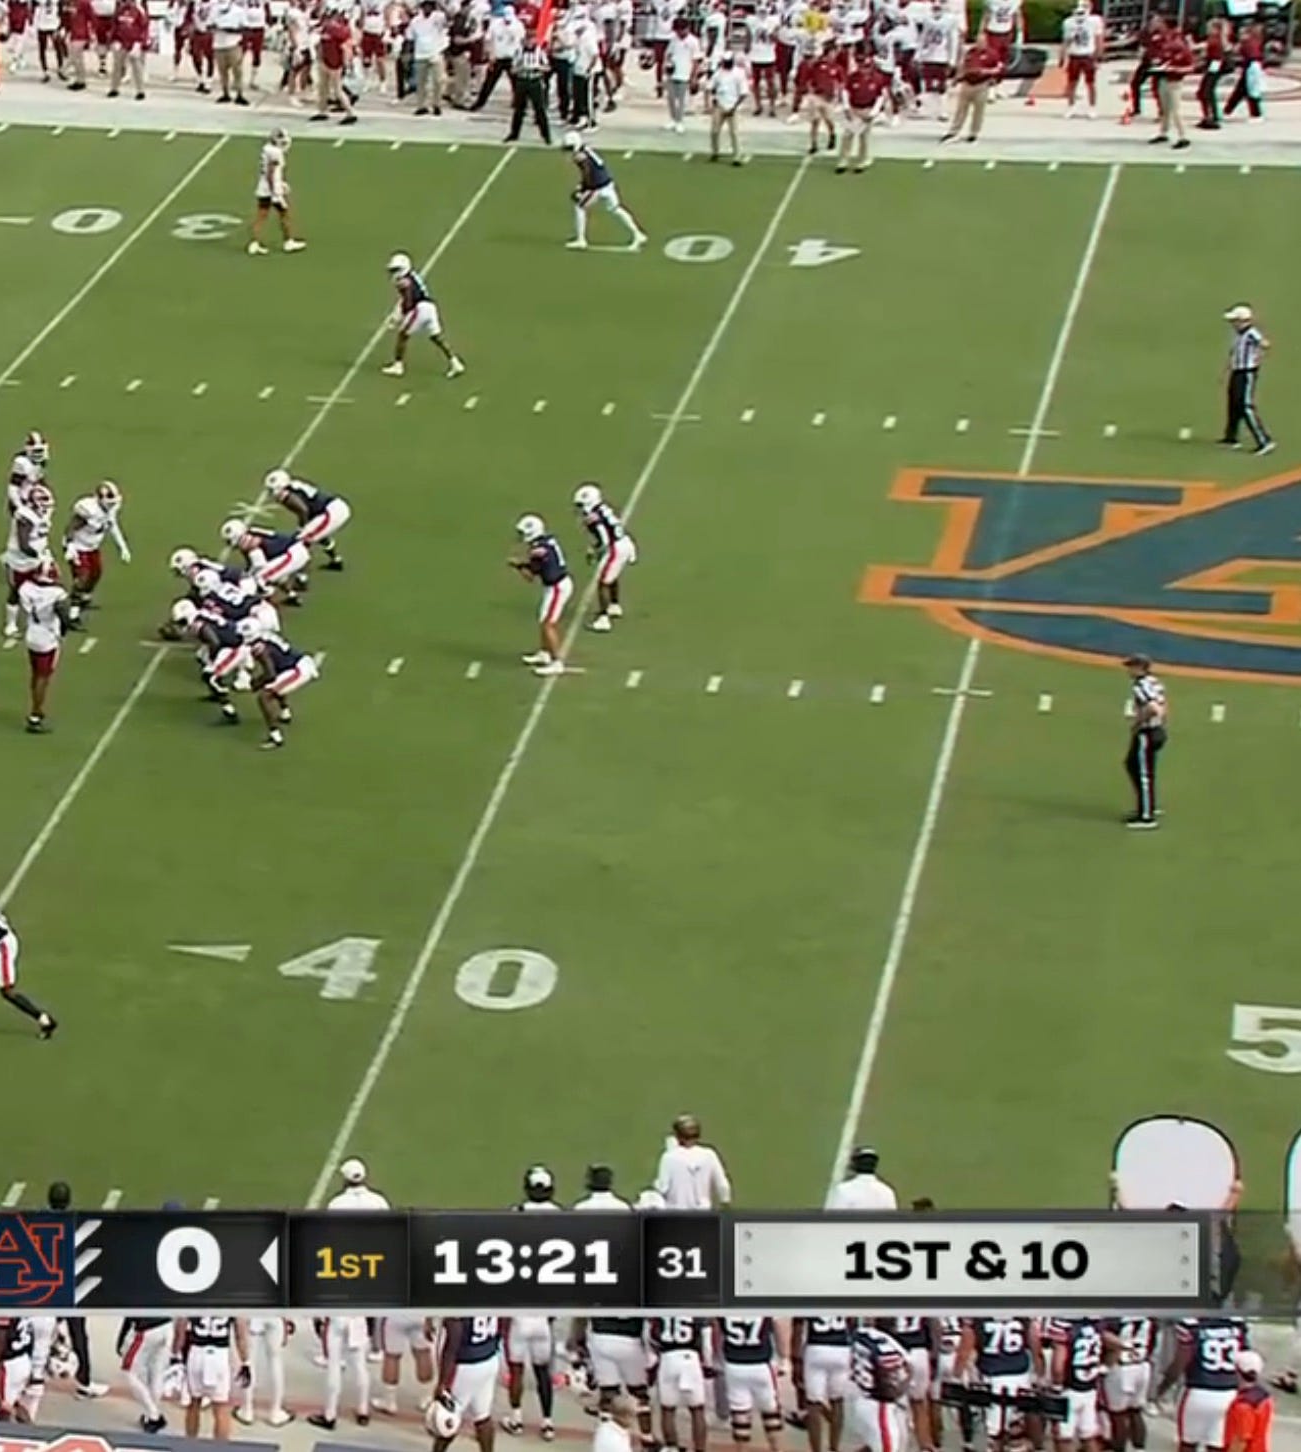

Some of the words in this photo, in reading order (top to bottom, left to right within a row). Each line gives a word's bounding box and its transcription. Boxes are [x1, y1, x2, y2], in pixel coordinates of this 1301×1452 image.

[660, 1316, 693, 1342] 16
[725, 1316, 765, 1346] 57
[983, 1321, 1024, 1354] 76
[1201, 1338, 1240, 1372] 93
